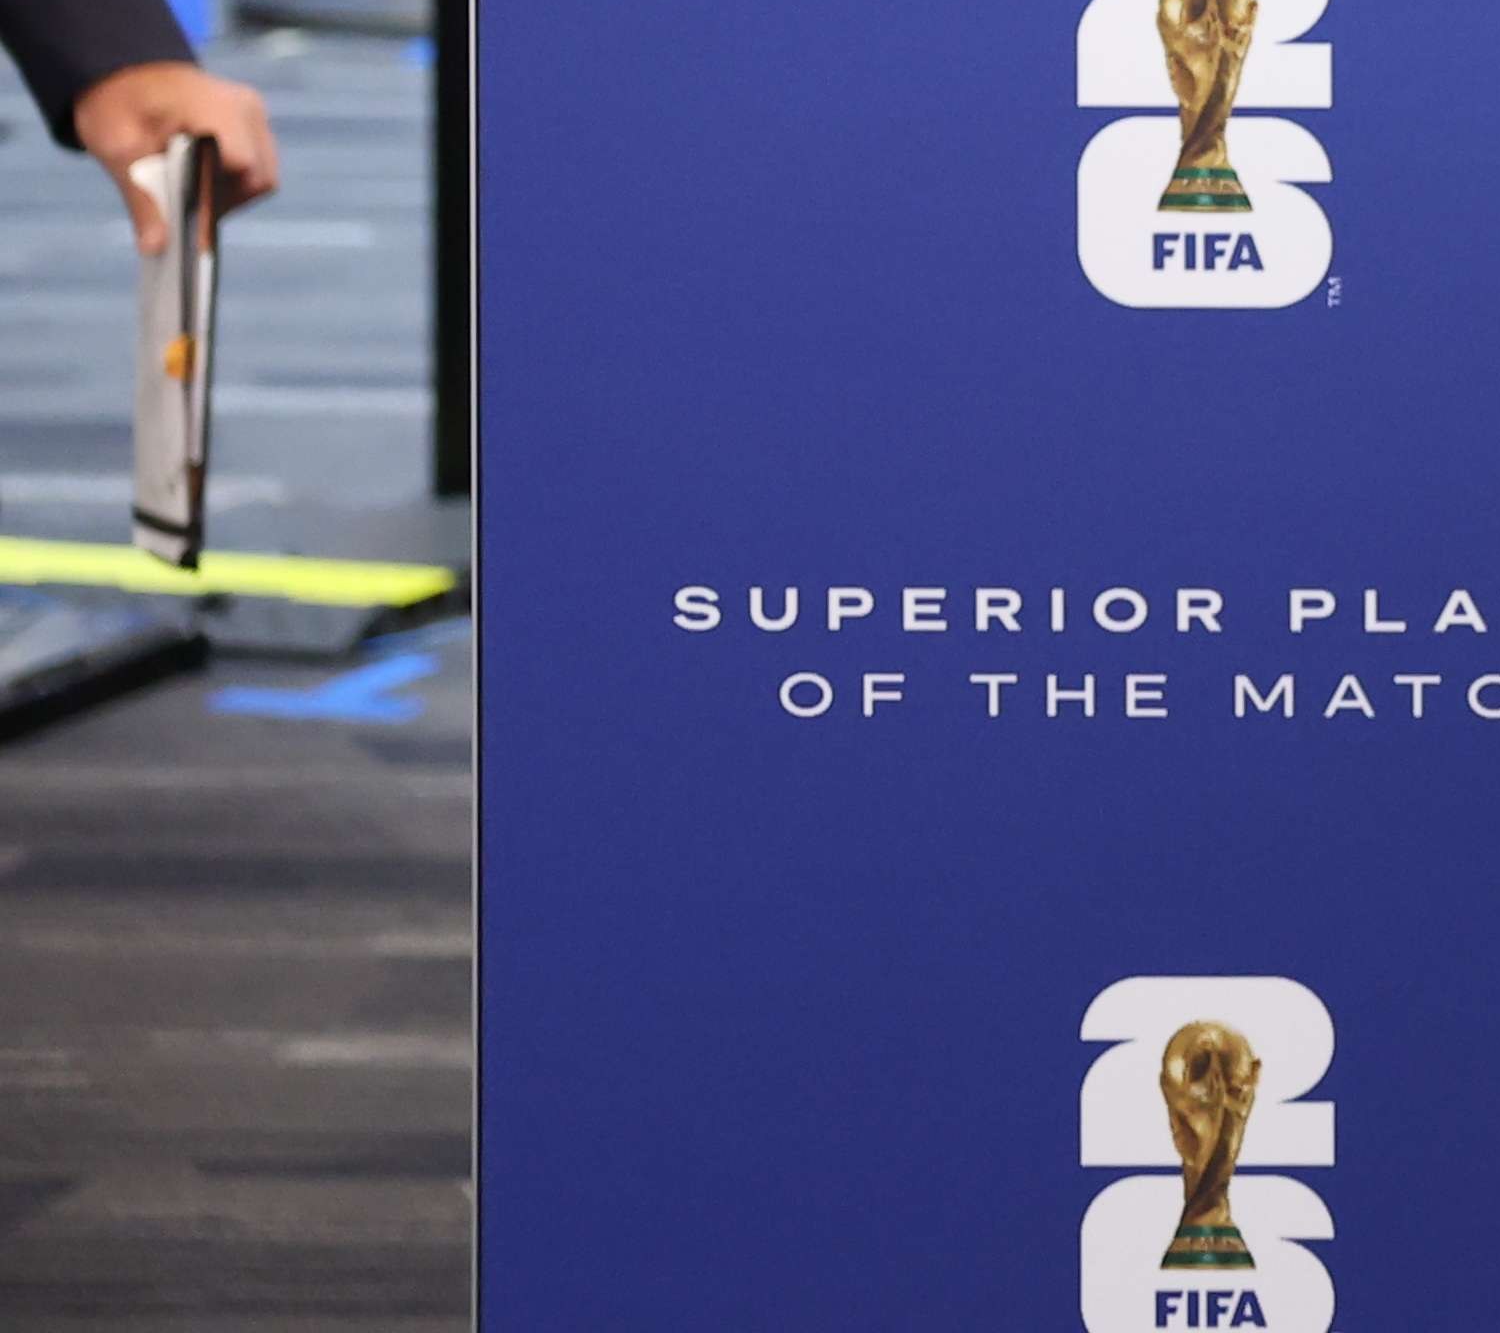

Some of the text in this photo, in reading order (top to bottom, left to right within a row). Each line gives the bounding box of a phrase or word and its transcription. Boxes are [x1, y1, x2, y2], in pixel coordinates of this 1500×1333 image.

[1152, 233, 1262, 271] FIFA
[673, 586, 1223, 633] SUPERIOR
[779, 672, 905, 718] OF
[969, 673, 1169, 718] THE
[1156, 1290, 1265, 1327] FIFA
